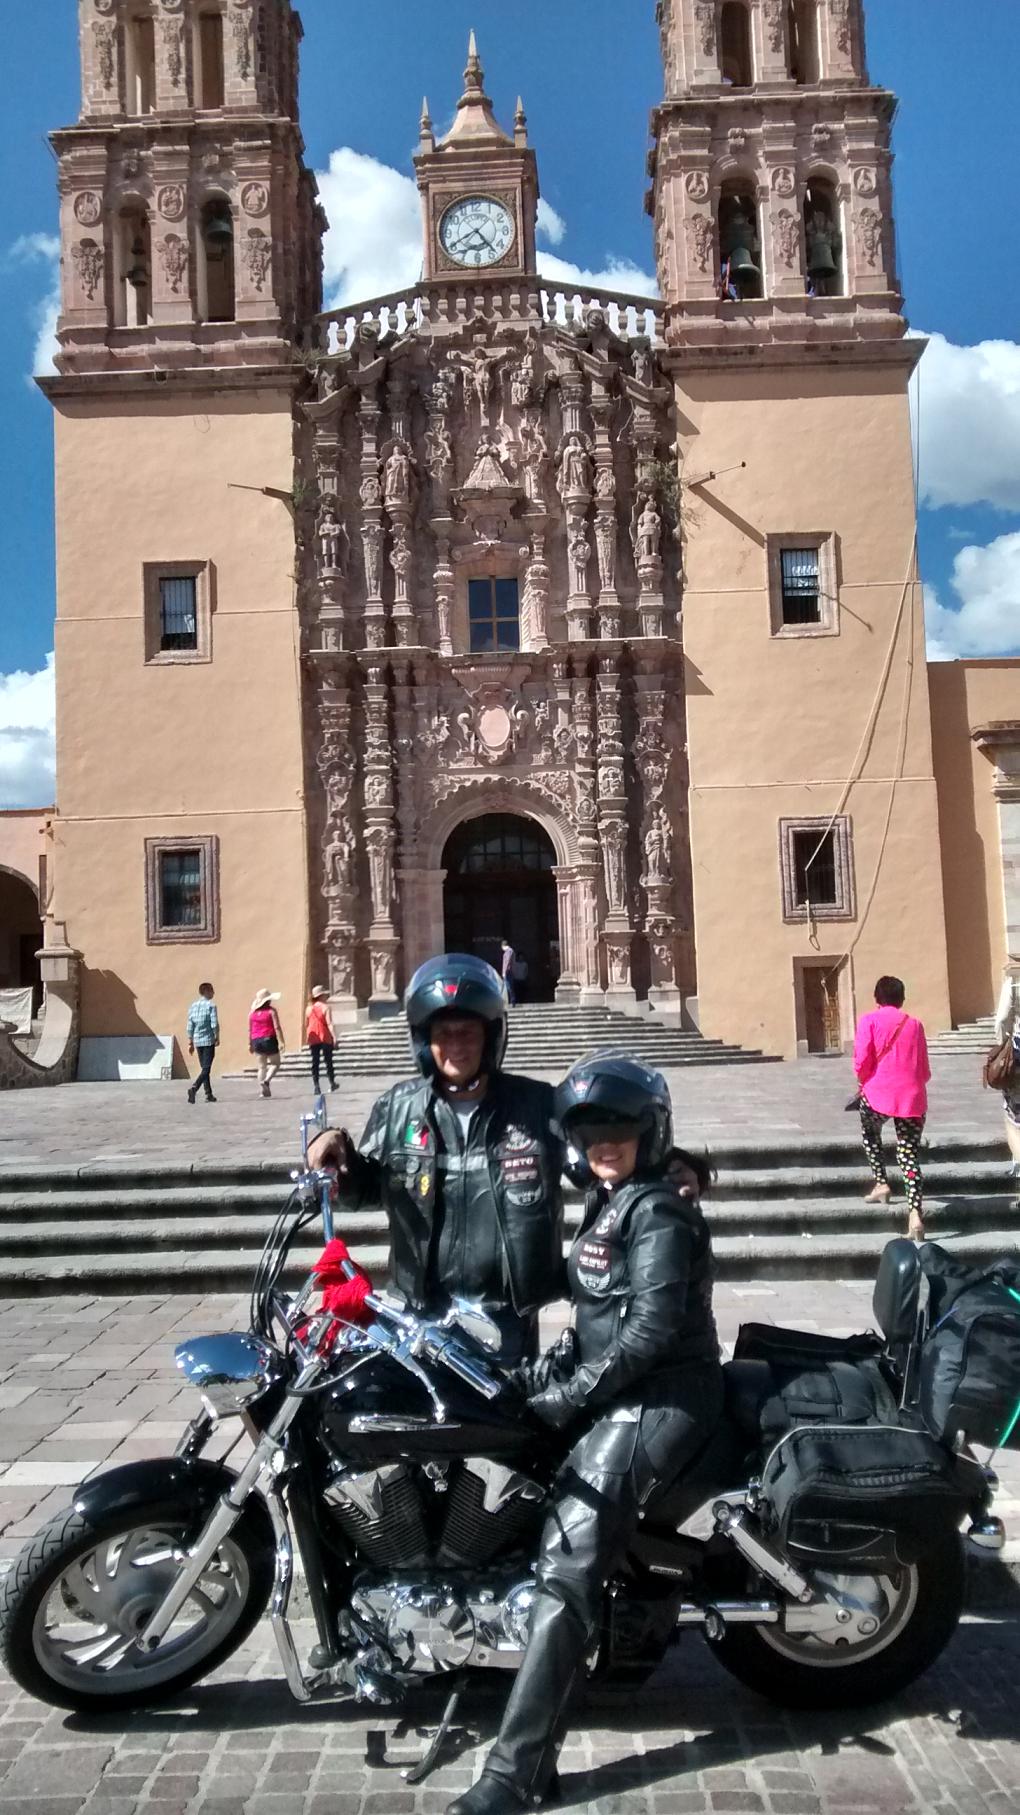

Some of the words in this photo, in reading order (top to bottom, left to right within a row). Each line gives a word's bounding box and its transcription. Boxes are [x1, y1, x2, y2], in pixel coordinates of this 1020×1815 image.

[497, 212, 504, 223] 2
[496, 239, 504, 249] 4
[474, 253, 481, 263] 6
[505, 1157, 534, 1168] BETO
